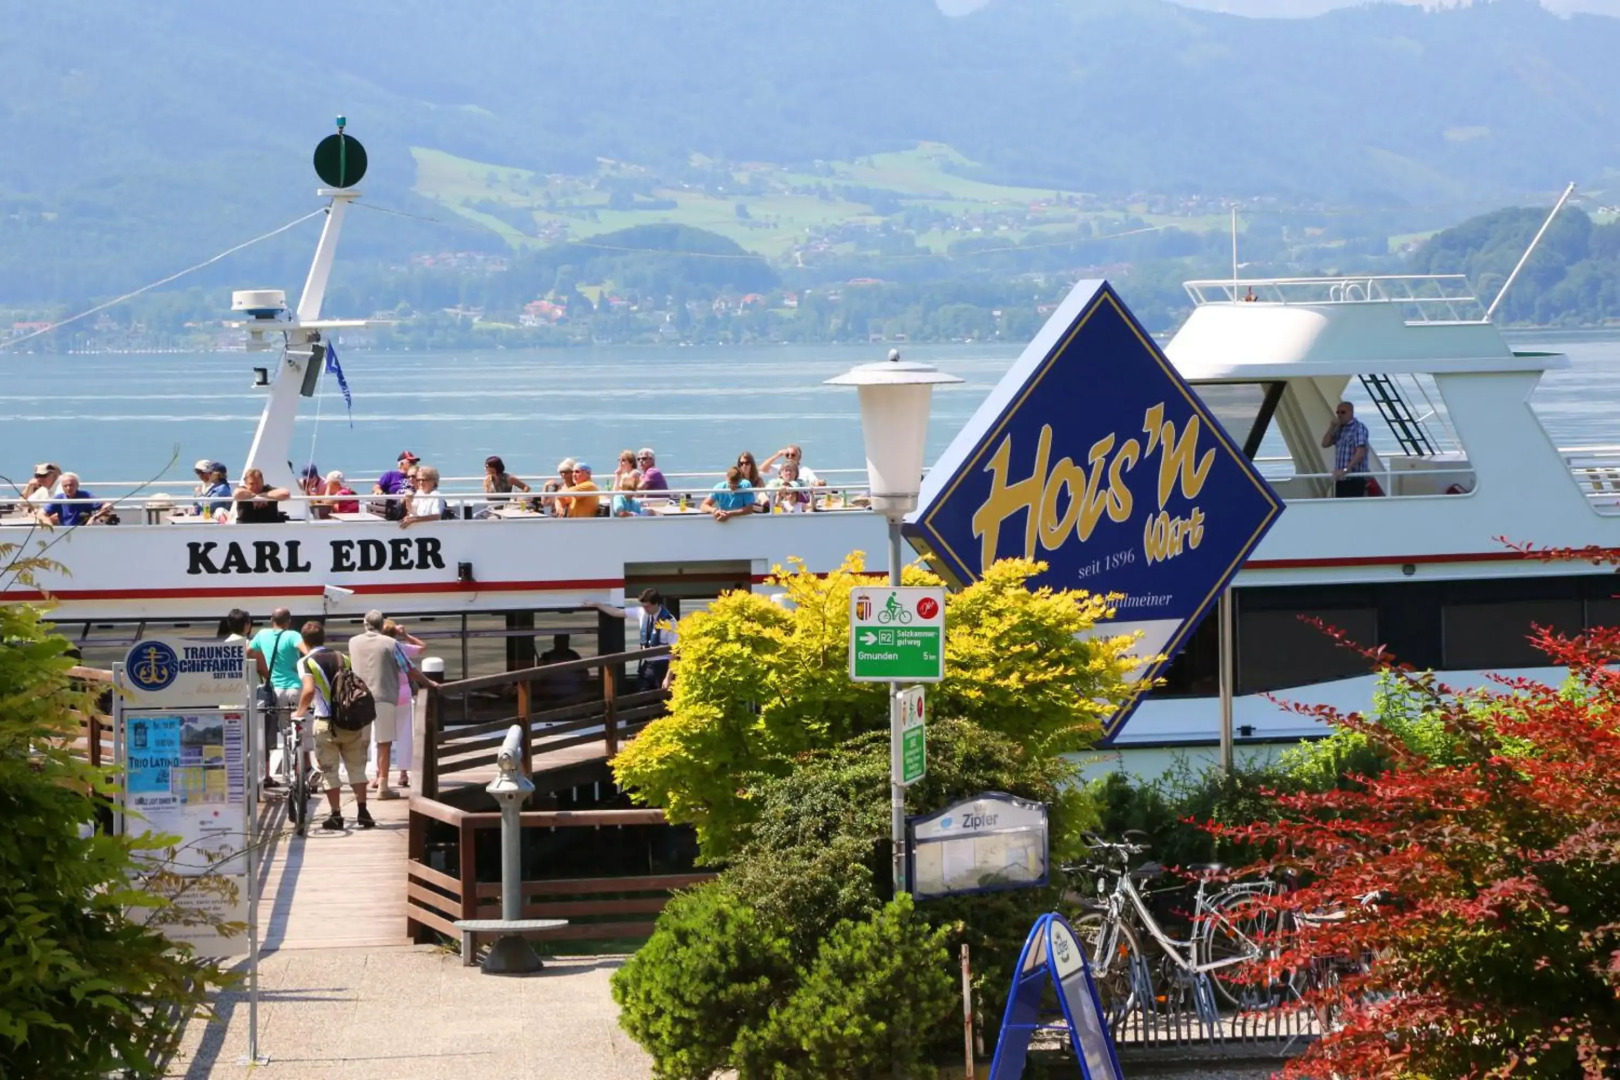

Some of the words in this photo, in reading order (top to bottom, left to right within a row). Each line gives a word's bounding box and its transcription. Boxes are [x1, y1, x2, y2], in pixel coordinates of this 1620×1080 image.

[1144, 506, 1205, 566] Wirt
[187, 541, 311, 574] KARL
[330, 537, 446, 573] EDER
[1078, 561, 1100, 579] seit
[1105, 548, 1135, 571] 1896
[880, 633, 892, 643] R2
[183, 645, 244, 660] TRAUNSEE
[858, 651, 899, 660] Gmunden
[923, 652, 929, 660] 5
[962, 813, 998, 830] Zipfer
